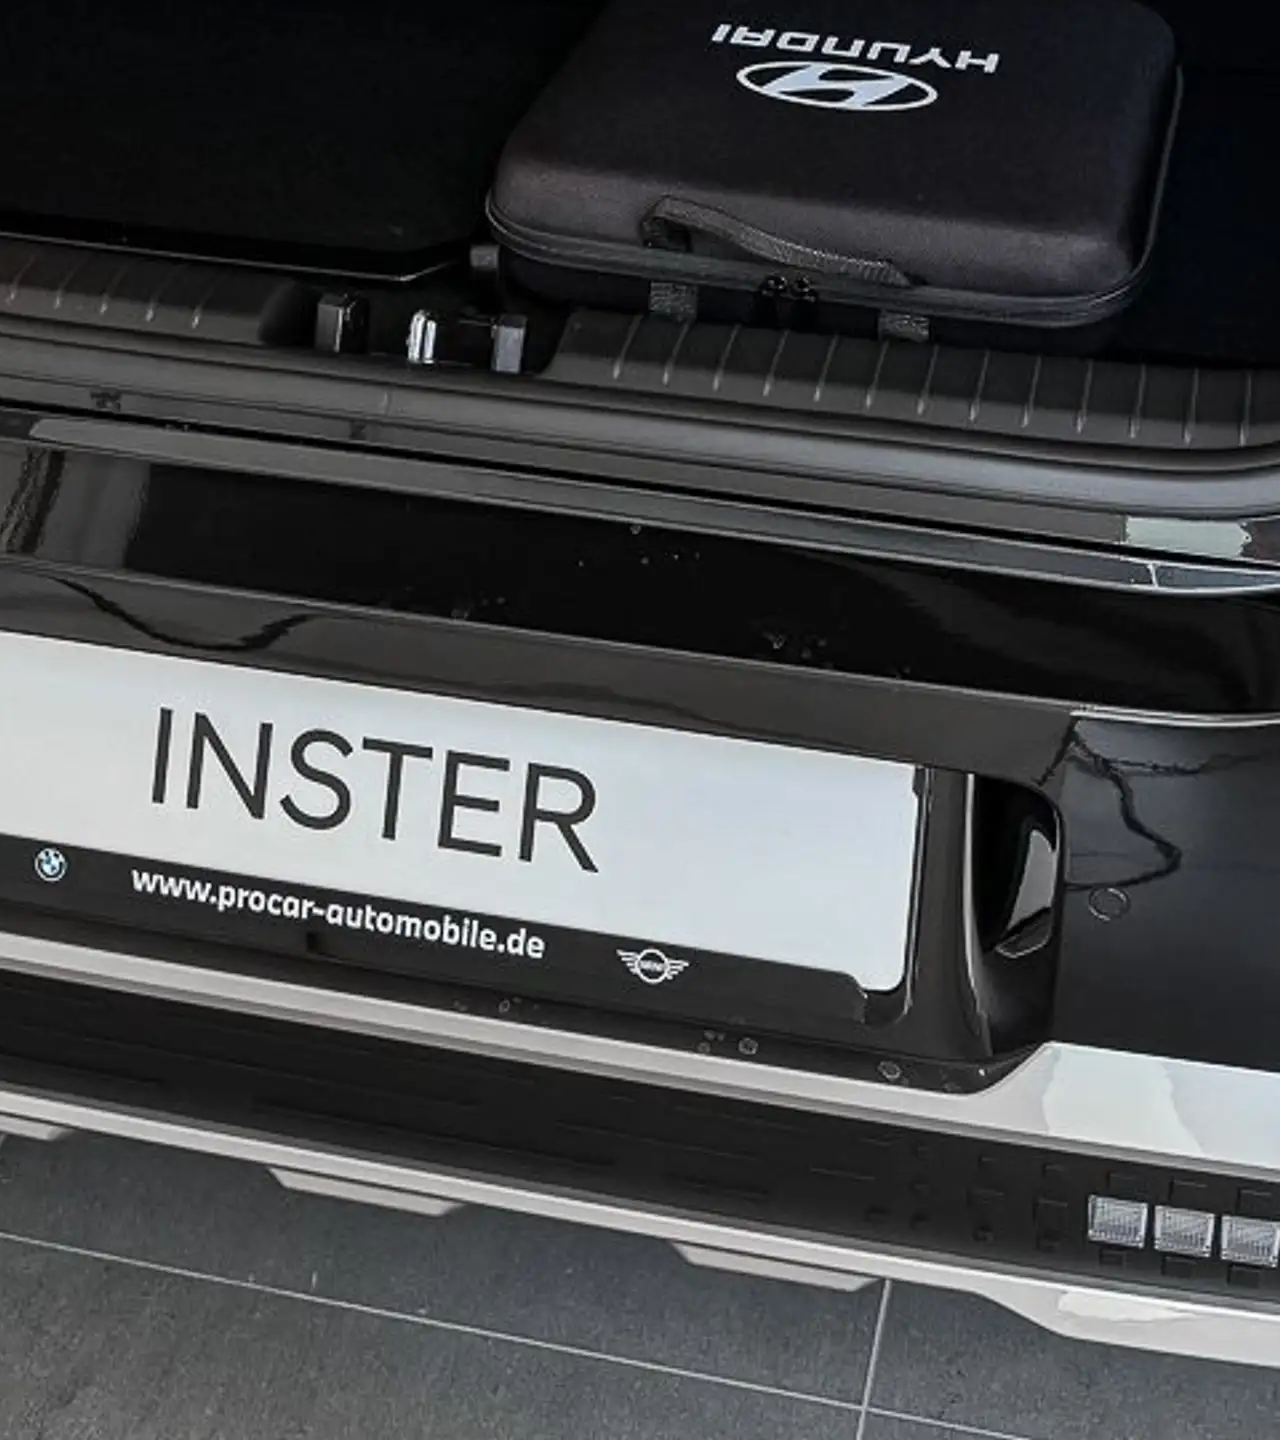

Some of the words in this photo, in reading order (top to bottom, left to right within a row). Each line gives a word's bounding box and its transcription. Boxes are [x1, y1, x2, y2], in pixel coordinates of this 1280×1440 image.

[712, 23, 1000, 74] HYUNDAI
[151, 707, 599, 874] INSTER
[131, 867, 546, 959] www.procar-automobile.de
